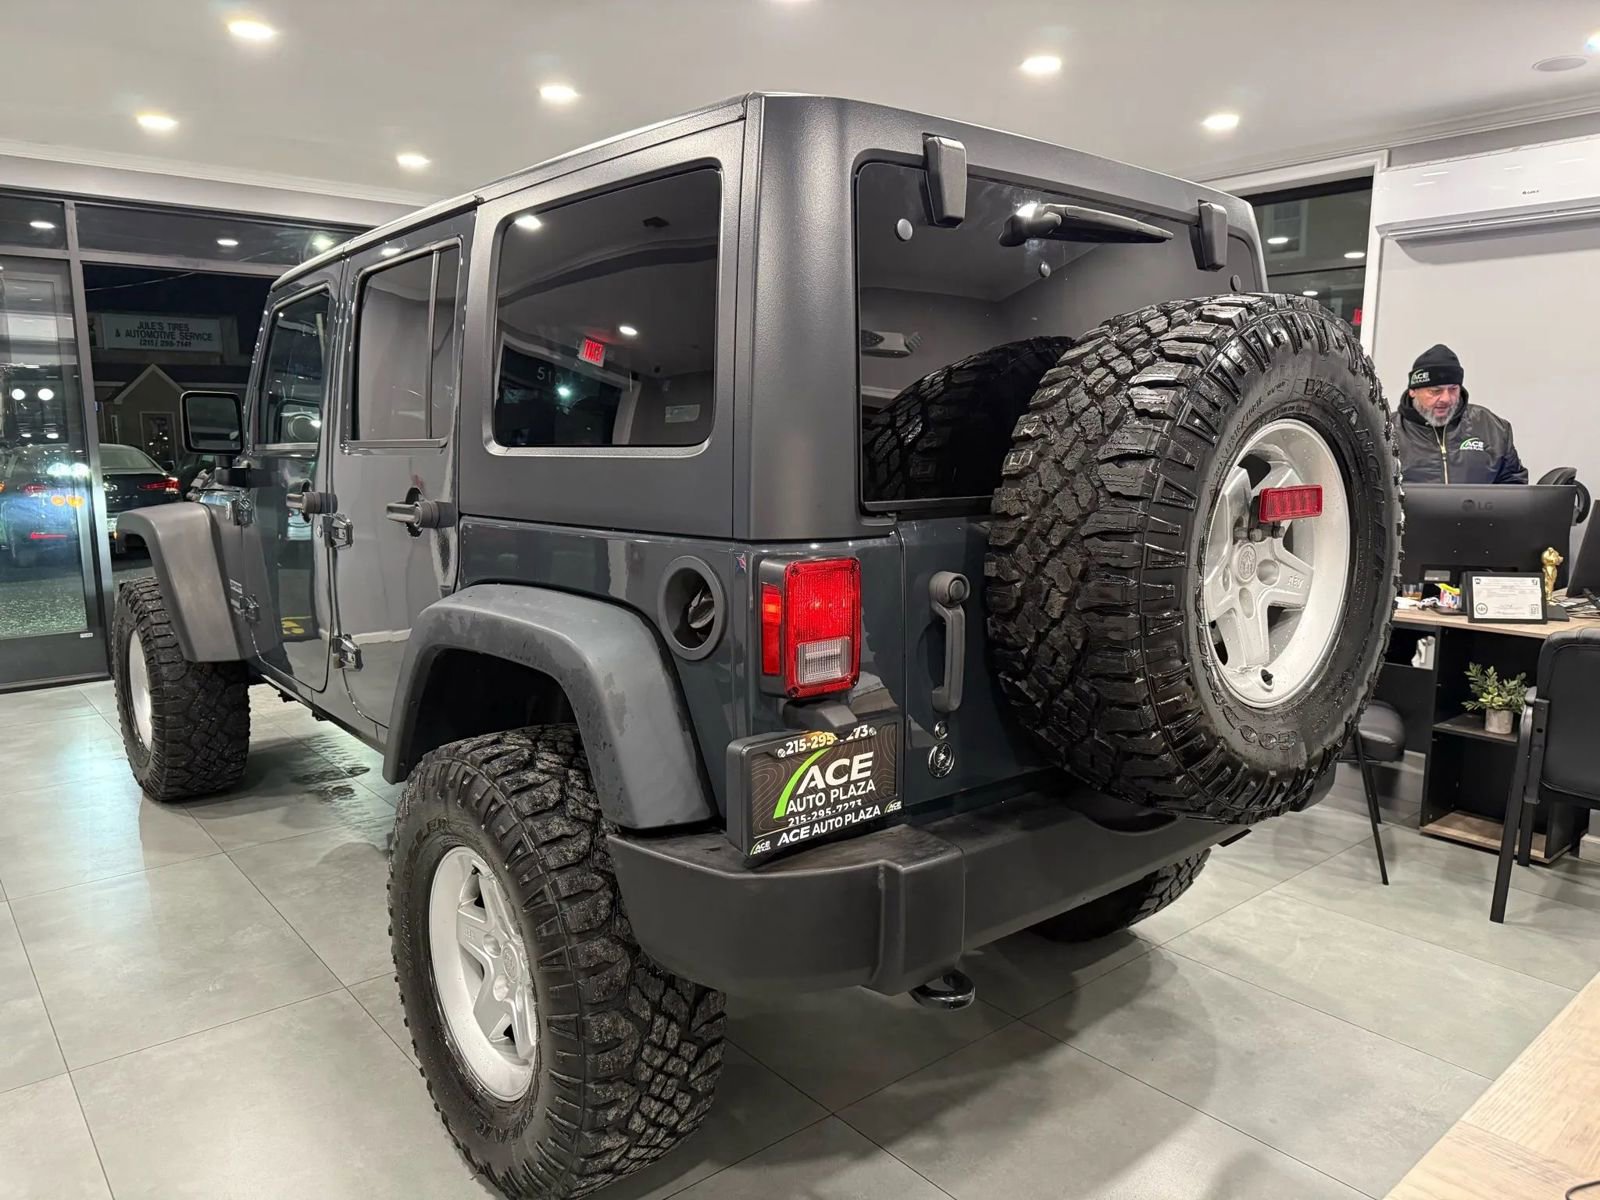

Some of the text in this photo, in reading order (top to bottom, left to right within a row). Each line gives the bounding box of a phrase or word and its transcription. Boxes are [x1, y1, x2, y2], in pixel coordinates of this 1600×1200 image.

[125, 329, 175, 340] AUTOMOTIVE
[180, 333, 213, 341] SERVICE
[137, 321, 189, 331] JULE'S TIRES
[1478, 502, 1493, 511] LG
[796, 752, 874, 795] ACE
[786, 779, 876, 814] AUTO PLAZA
[777, 805, 881, 846] ACE AUTO PLAZA
